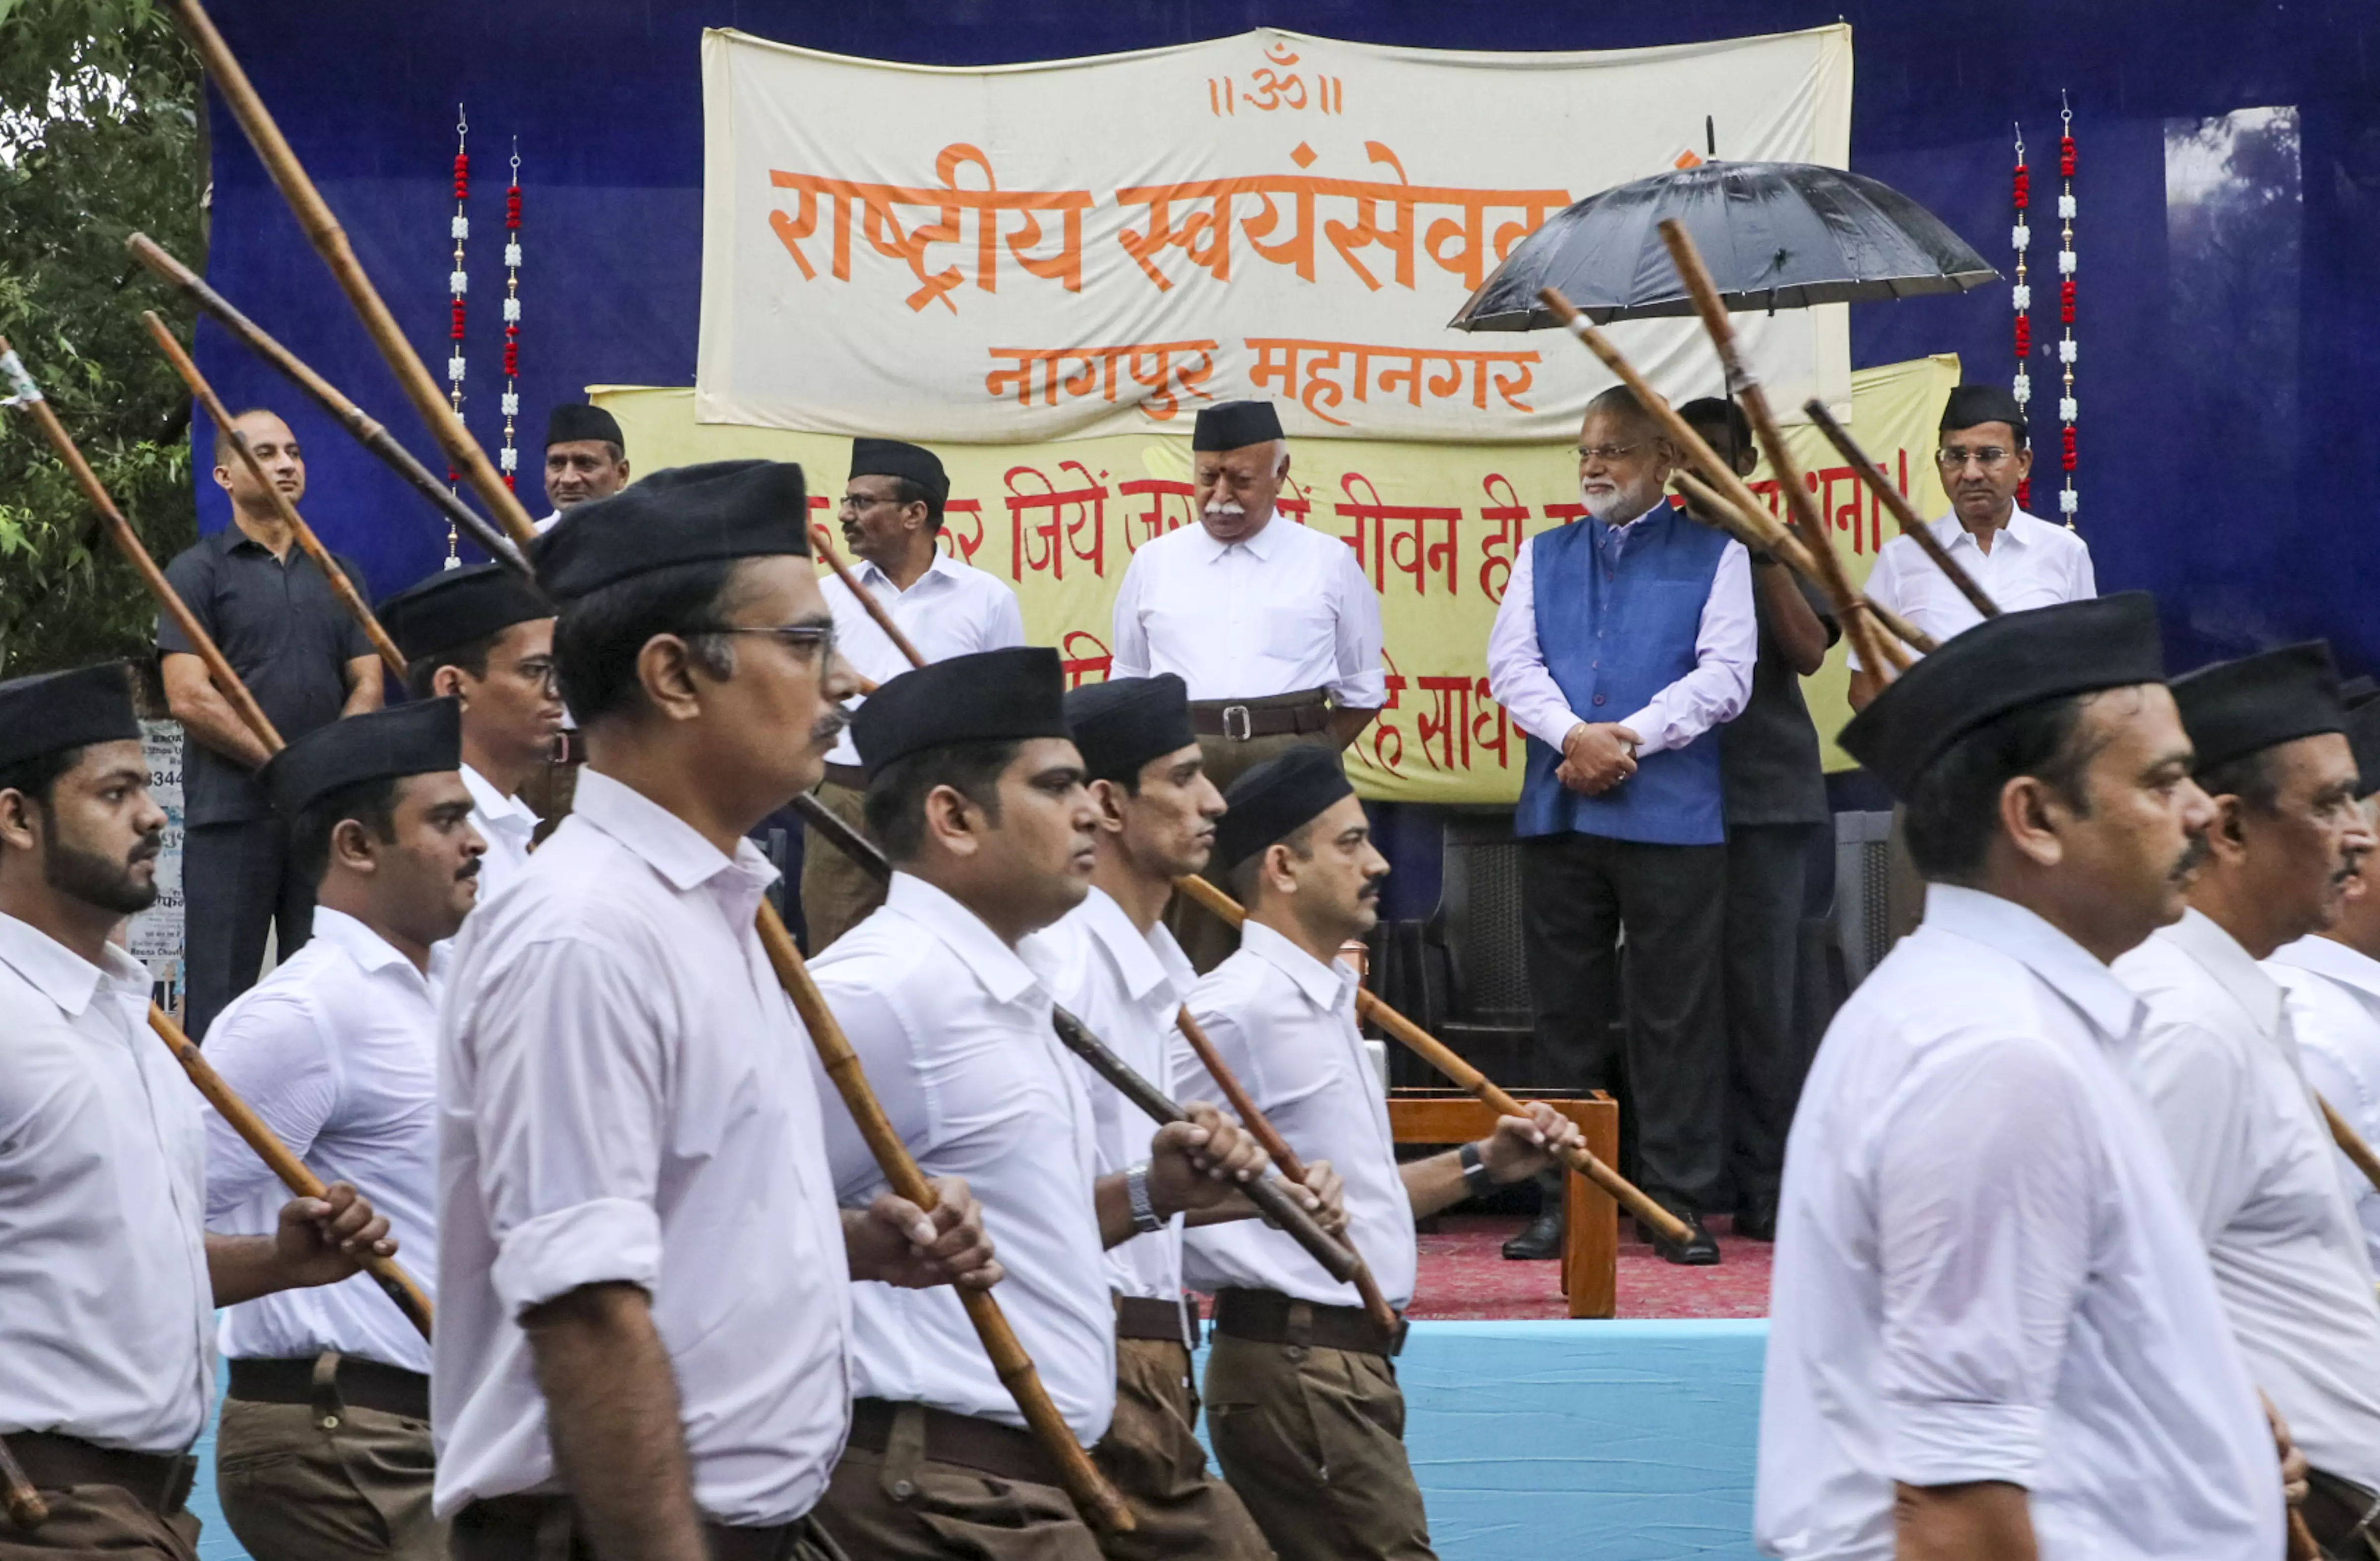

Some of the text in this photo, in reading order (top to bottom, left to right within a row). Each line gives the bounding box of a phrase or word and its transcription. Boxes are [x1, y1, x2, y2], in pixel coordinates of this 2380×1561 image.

[769, 142, 1094, 316] राष्ट्रीय
[985, 338, 1541, 425] नागपुर महानगर
[1005, 461, 1110, 583] जियें
[1480, 473, 1531, 605] ही
